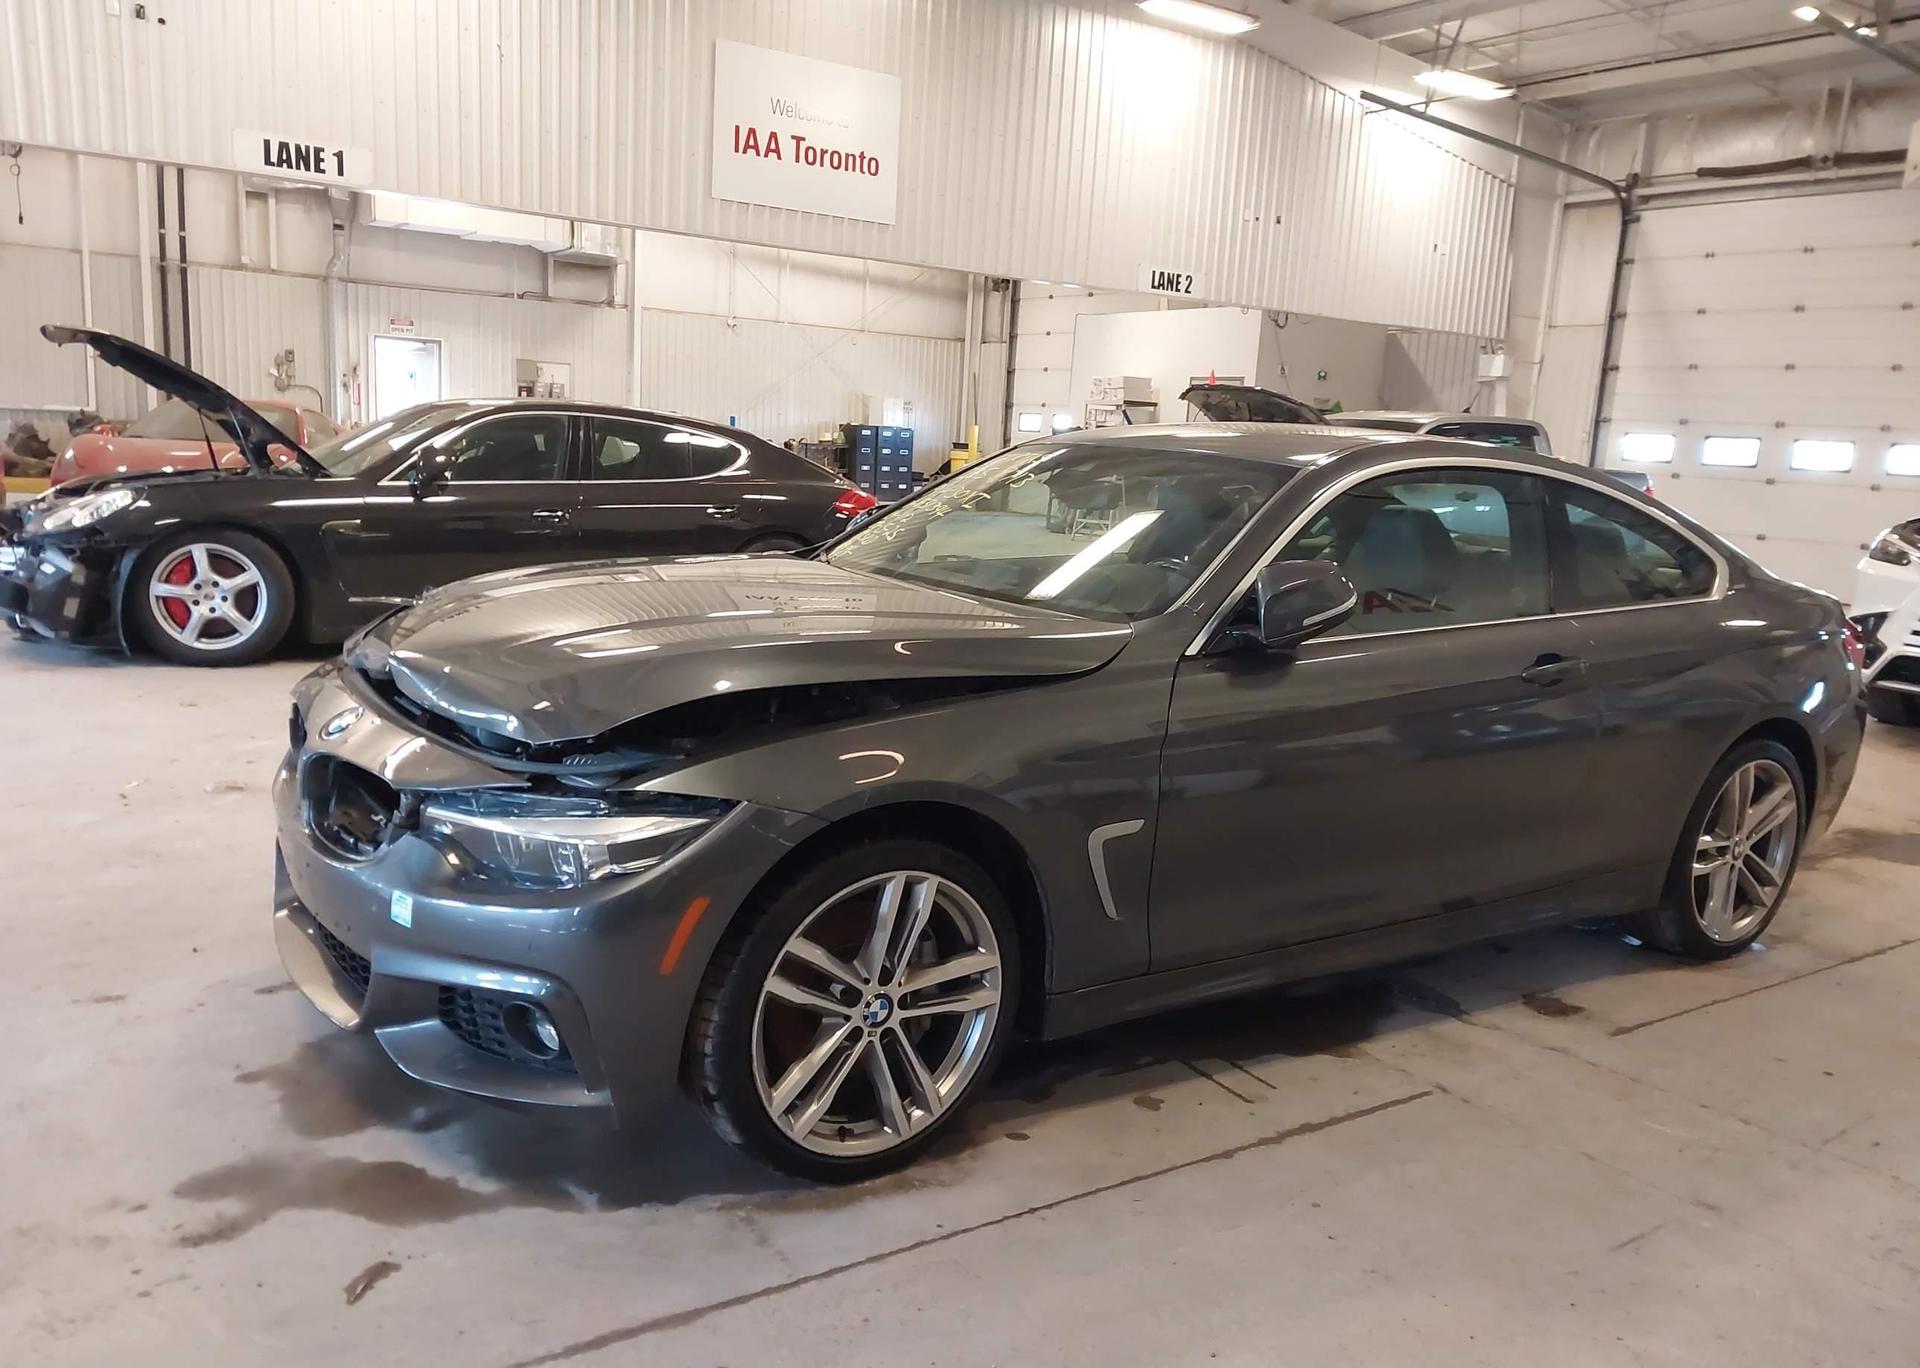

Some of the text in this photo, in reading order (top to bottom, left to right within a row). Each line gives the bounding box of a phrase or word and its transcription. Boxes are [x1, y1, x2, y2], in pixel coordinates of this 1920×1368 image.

[263, 138, 344, 177] LANE 1
[733, 124, 880, 177] IAA Toronto
[1151, 270, 1193, 294] LANE 2
